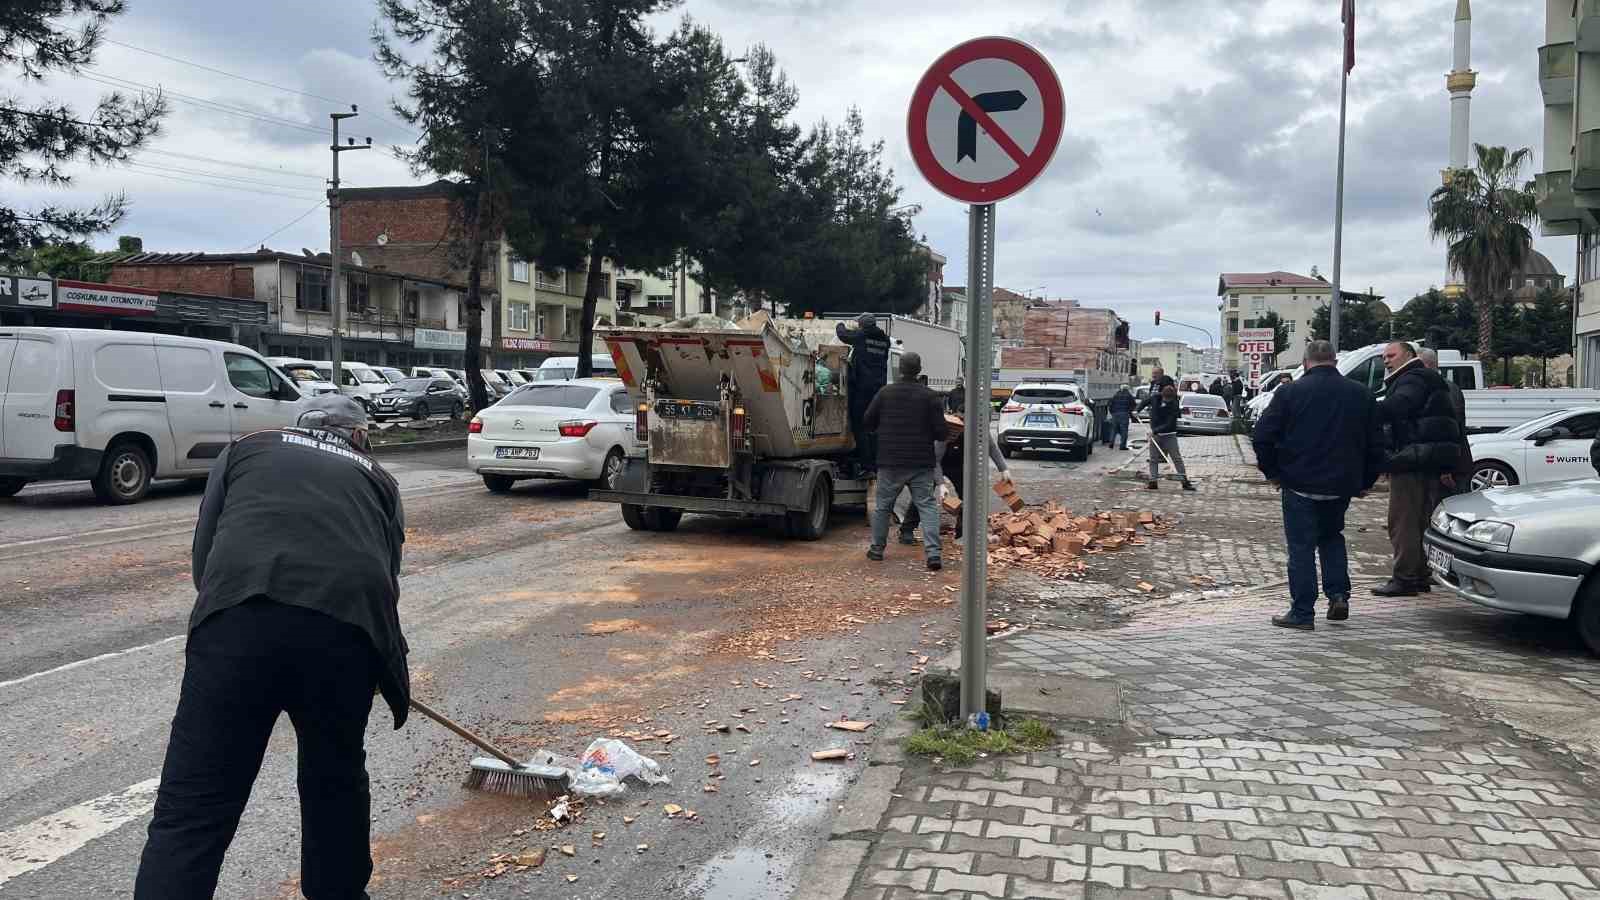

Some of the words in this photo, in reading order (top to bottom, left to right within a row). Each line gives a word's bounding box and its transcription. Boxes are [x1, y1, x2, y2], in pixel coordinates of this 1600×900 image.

[1238, 342, 1274, 352] OTEL
[1250, 353, 1260, 388] OTEL
[281, 433, 318, 449] TERME
